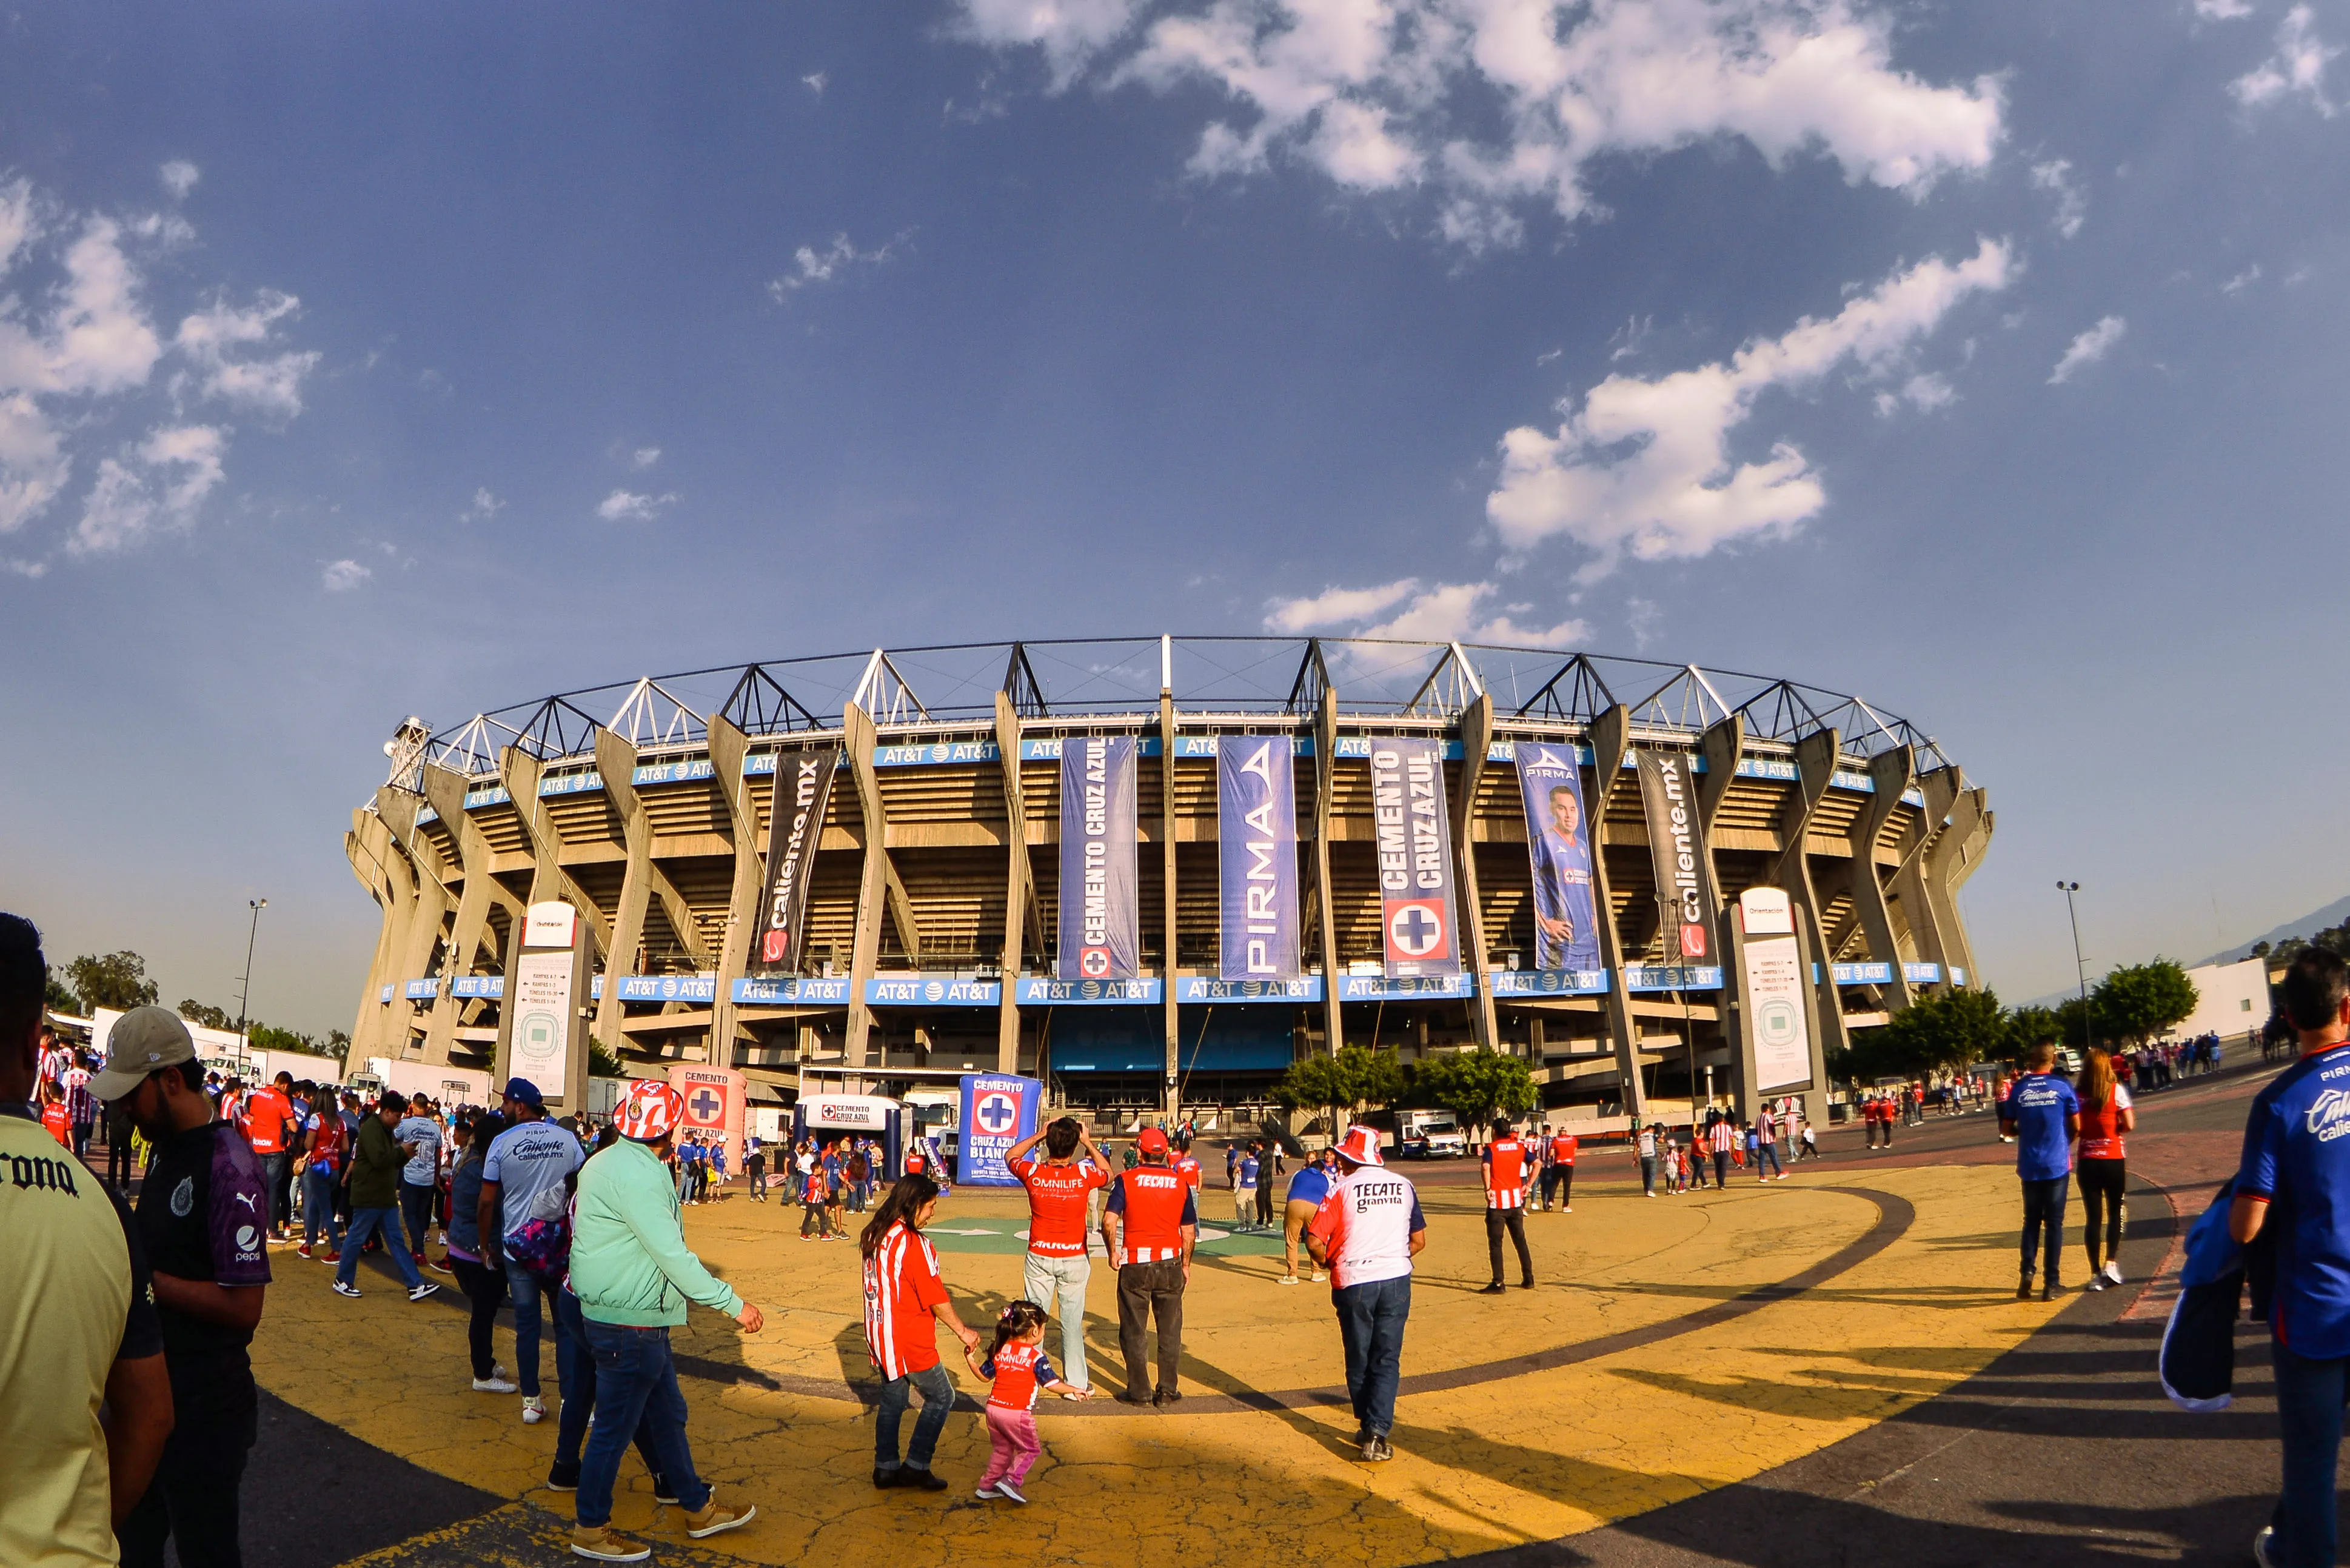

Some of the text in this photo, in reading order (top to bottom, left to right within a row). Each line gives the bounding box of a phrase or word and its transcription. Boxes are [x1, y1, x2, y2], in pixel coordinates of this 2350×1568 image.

[883, 744, 999, 763] AT&T AT&T
[1031, 742, 1062, 756] AT&
[1185, 738, 1218, 754] AT&
[1339, 739, 1370, 755] AT&
[1487, 743, 1514, 759] AT&
[638, 762, 716, 782] AT&T AT&
[752, 757, 777, 772] AT&
[1767, 763, 1795, 778] AT&T
[1525, 768, 1575, 781] PIRMA
[1847, 775, 1869, 789] AT&T
[543, 773, 604, 793] AT&T AT
[469, 790, 492, 806] AT&T
[1373, 750, 1408, 890] CEMENTO
[1407, 750, 1443, 890] CRUZ AZUL
[771, 759, 818, 929] caliente.mx
[1085, 737, 1108, 946] CEMENTO CRUZ AZUL
[1658, 758, 1701, 924] caliente.mx
[1245, 801, 1277, 974] PIRMA
[1626, 969, 1715, 986] AT&T AT&T
[1833, 965, 1885, 980] T&T AT&T
[1920, 965, 1935, 979] AT&T
[408, 982, 423, 995] AT&T
[456, 979, 478, 993] AT&T
[490, 979, 504, 993] AT
[624, 981, 715, 998] AT&T AT&T
[1188, 979, 1314, 998] AT&T AT&T
[1347, 976, 1464, 996] AT&T AT&T
[1496, 971, 1599, 992] AT&T AT&T
[741, 982, 845, 999] AT&T AT&T
[875, 983, 994, 1000] AT&T AT&T
[1028, 982, 1153, 999] AT&T AT&T
[685, 1072, 728, 1084] CEMENTO
[973, 1079, 1023, 1093] CEMENTO
[1168, 1076, 1174, 1085] 4
[836, 1112, 853, 1121] CRUZ
[512, 1138, 565, 1156] Caliente
[970, 1136, 996, 1147] CRUZ
[518, 1151, 564, 1161] caliente.mx
[970, 1147, 1006, 1159] BLAN
[1032, 1176, 1084, 1190] OMNILIFE
[1134, 1174, 1177, 1189] TECATE
[1353, 1183, 1403, 1198] TECATE
[1357, 1195, 1402, 1214] granvita
[236, 1251, 260, 1262] pepsi
